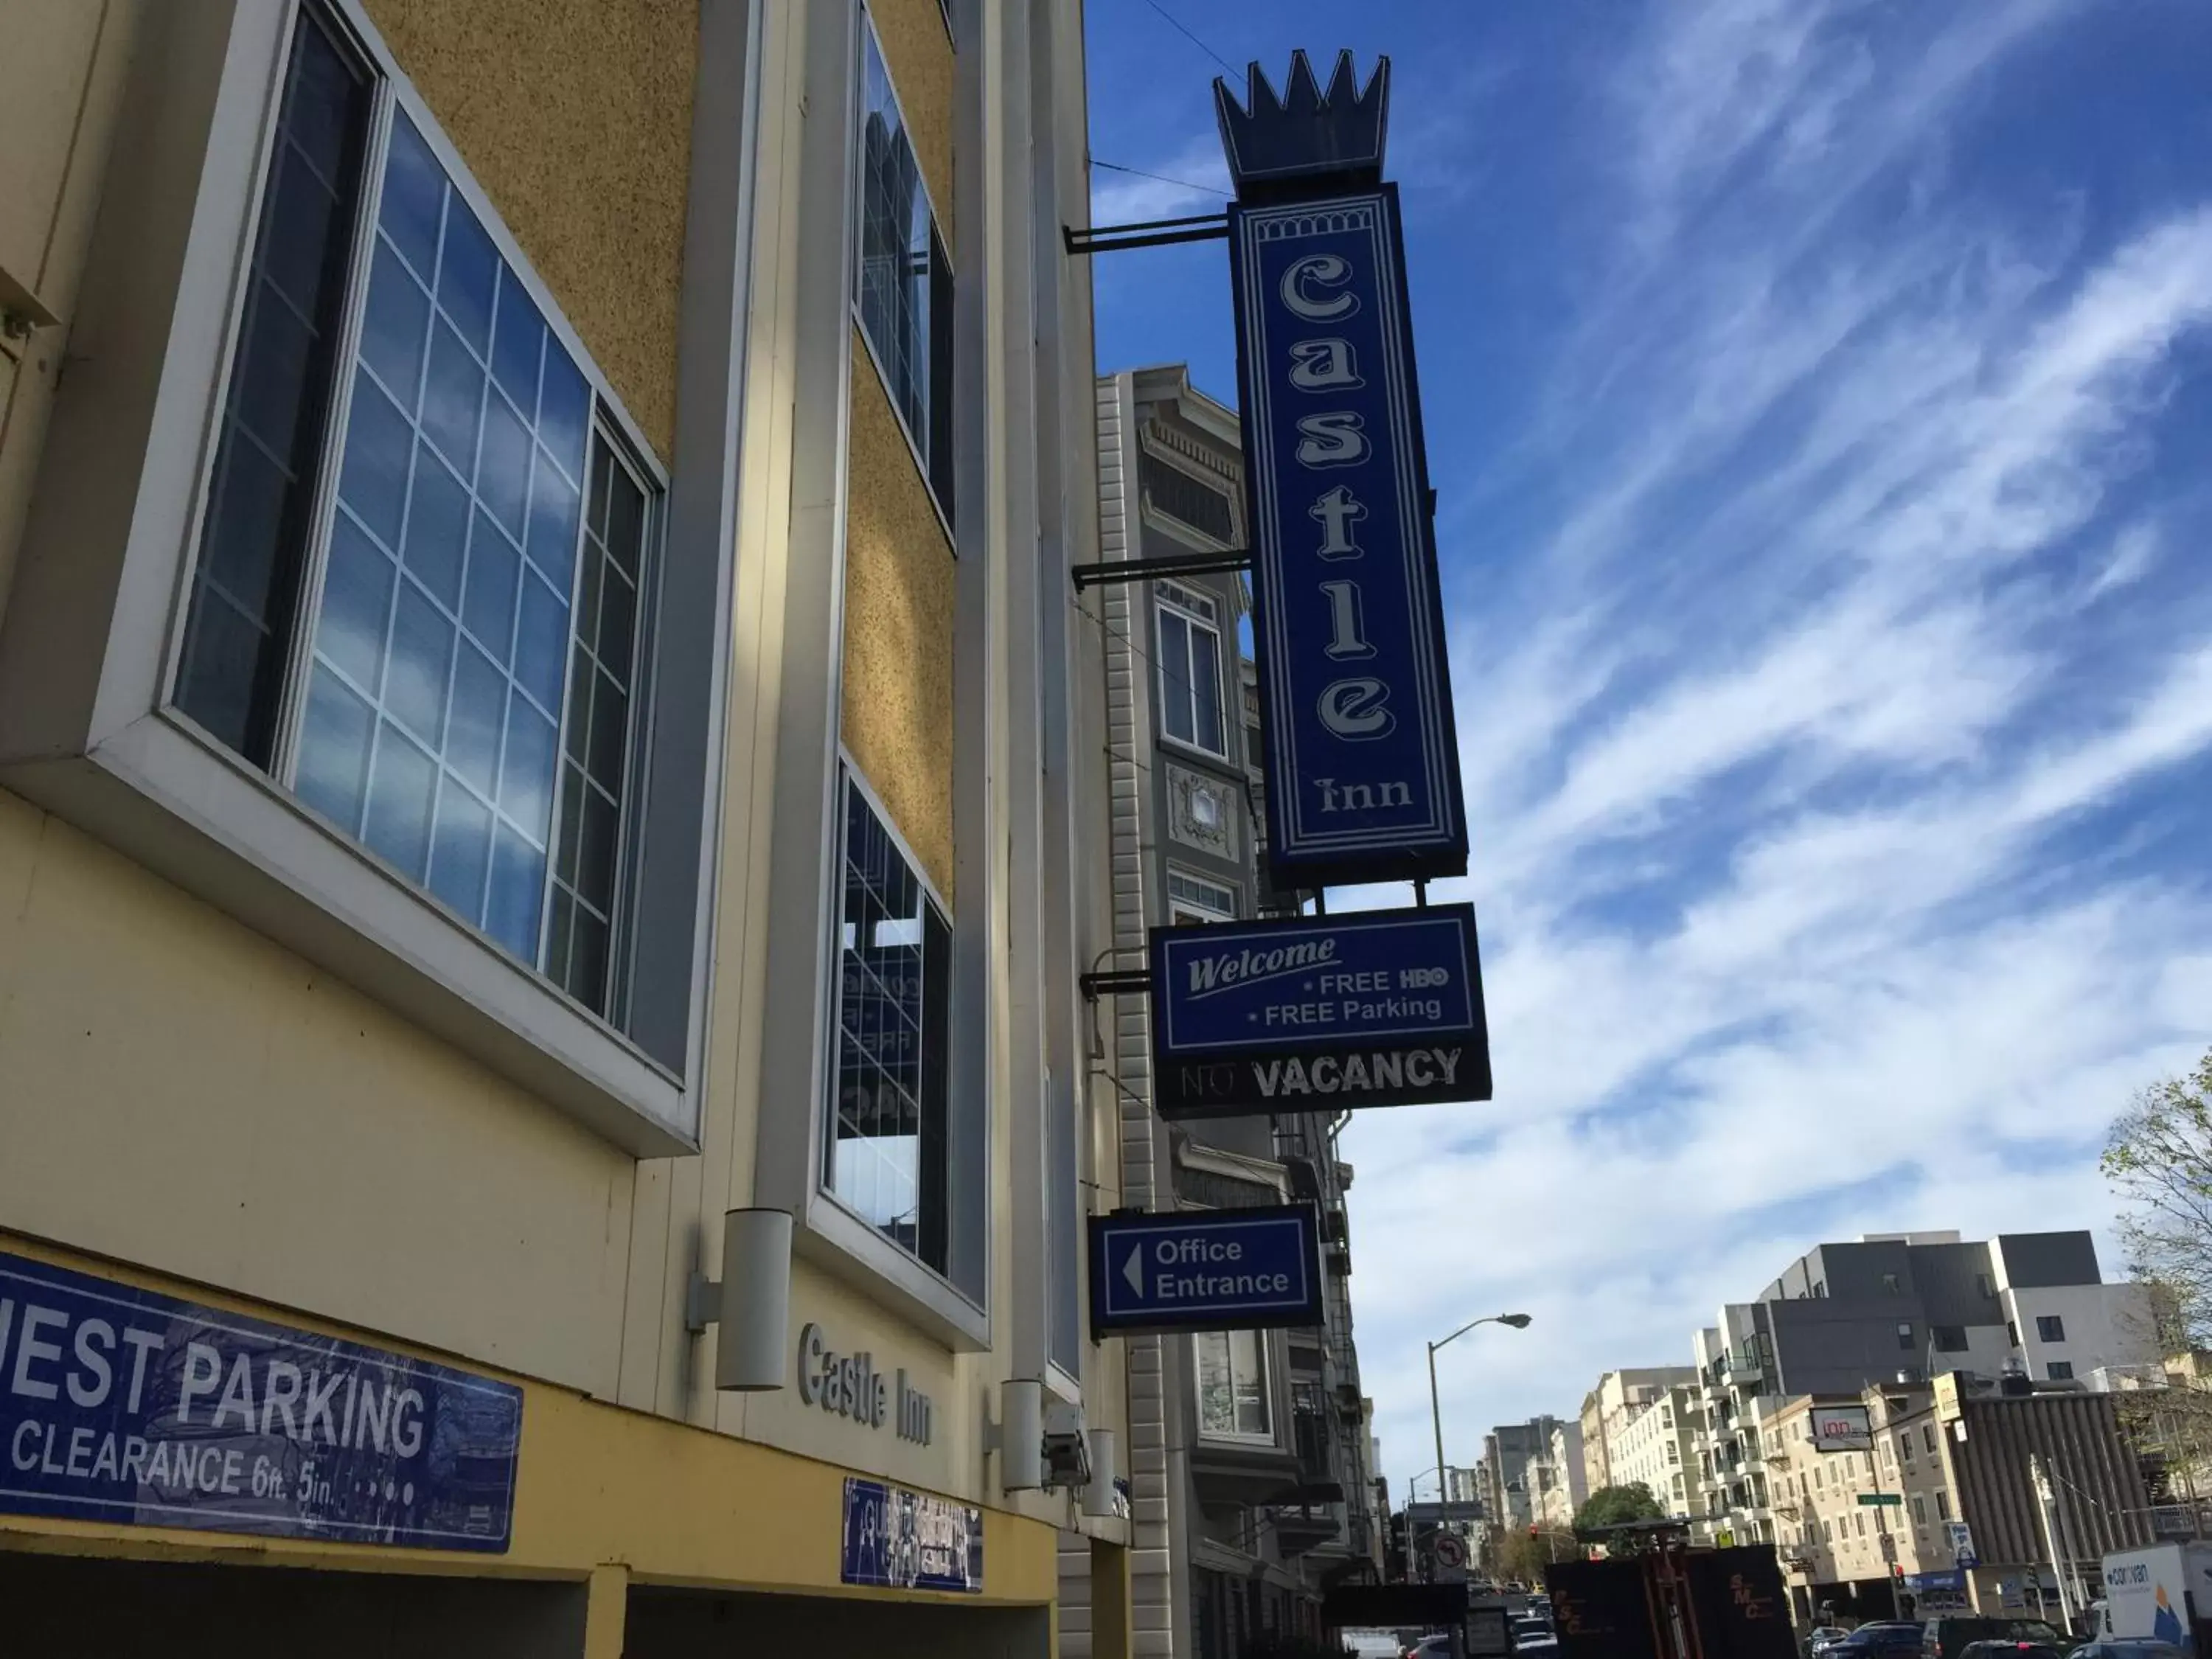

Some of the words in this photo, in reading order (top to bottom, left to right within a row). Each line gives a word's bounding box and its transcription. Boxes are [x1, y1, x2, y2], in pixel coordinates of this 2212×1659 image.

[1280, 254, 1397, 741] Castle
[1186, 937, 1336, 992] Welcome
[1320, 970, 1391, 995] FREE
[1400, 967, 1450, 989] HBO
[1266, 1001, 1335, 1026] FREE
[1343, 997, 1441, 1022] Parking
[1251, 1047, 1462, 1097] VACANCY
[1155, 1238, 1242, 1265] Office
[1156, 1273, 1289, 1298] Entrance
[0, 1297, 164, 1414] EST
[176, 1341, 424, 1458] PARKING
[798, 1322, 887, 1430] Castle
[897, 1368, 933, 1447] Inn
[11, 1419, 245, 1495] CLEARANCE
